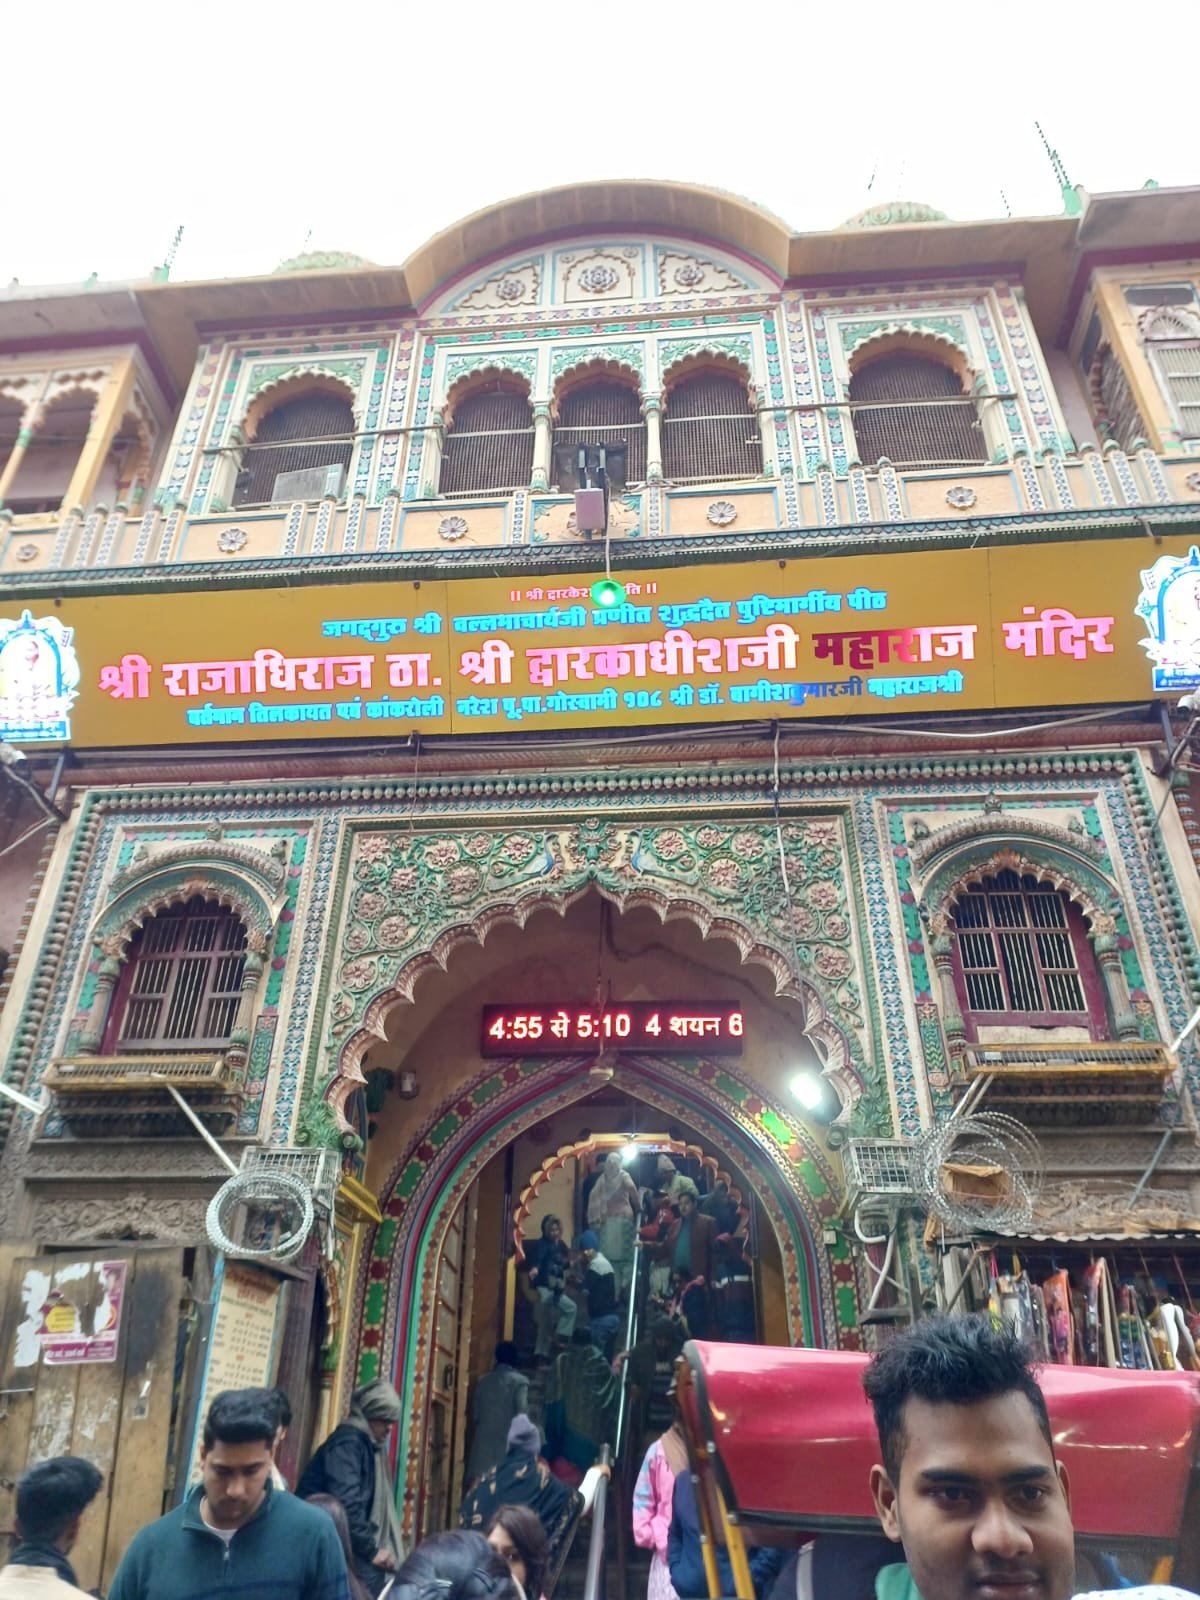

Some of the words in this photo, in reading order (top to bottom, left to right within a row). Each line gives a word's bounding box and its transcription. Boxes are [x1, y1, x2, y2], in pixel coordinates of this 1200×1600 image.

[412, 611, 442, 635] श्री
[591, 602, 653, 626] प्रणीत
[846, 586, 888, 611] पीठ
[526, 587, 544, 601] श्री
[98, 653, 151, 699] श्री
[161, 648, 375, 697] राजाधिराज
[384, 653, 442, 689] ठा.
[458, 638, 515, 685] श्री
[525, 623, 800, 687] द्वारकाधीशजी
[812, 624, 978, 670] महाराज
[1002, 606, 1115, 660] मंदिर
[186, 702, 246, 726] वर्तमान
[248, 701, 332, 724] तिलकायत
[335, 695, 362, 720] एवं
[365, 694, 445, 719] कांकरोली
[455, 695, 498, 716] नरेश
[669, 682, 694, 707] श्री
[867, 669, 964, 699] महाराजश्री
[489, 1016, 543, 1040] 4:55
[550, 1012, 570, 1039] से
[577, 1013, 631, 1039] 5:10
[645, 1014, 661, 1037] 4
[669, 1016, 721, 1037] शयन
[728, 1013, 743, 1037] 6
